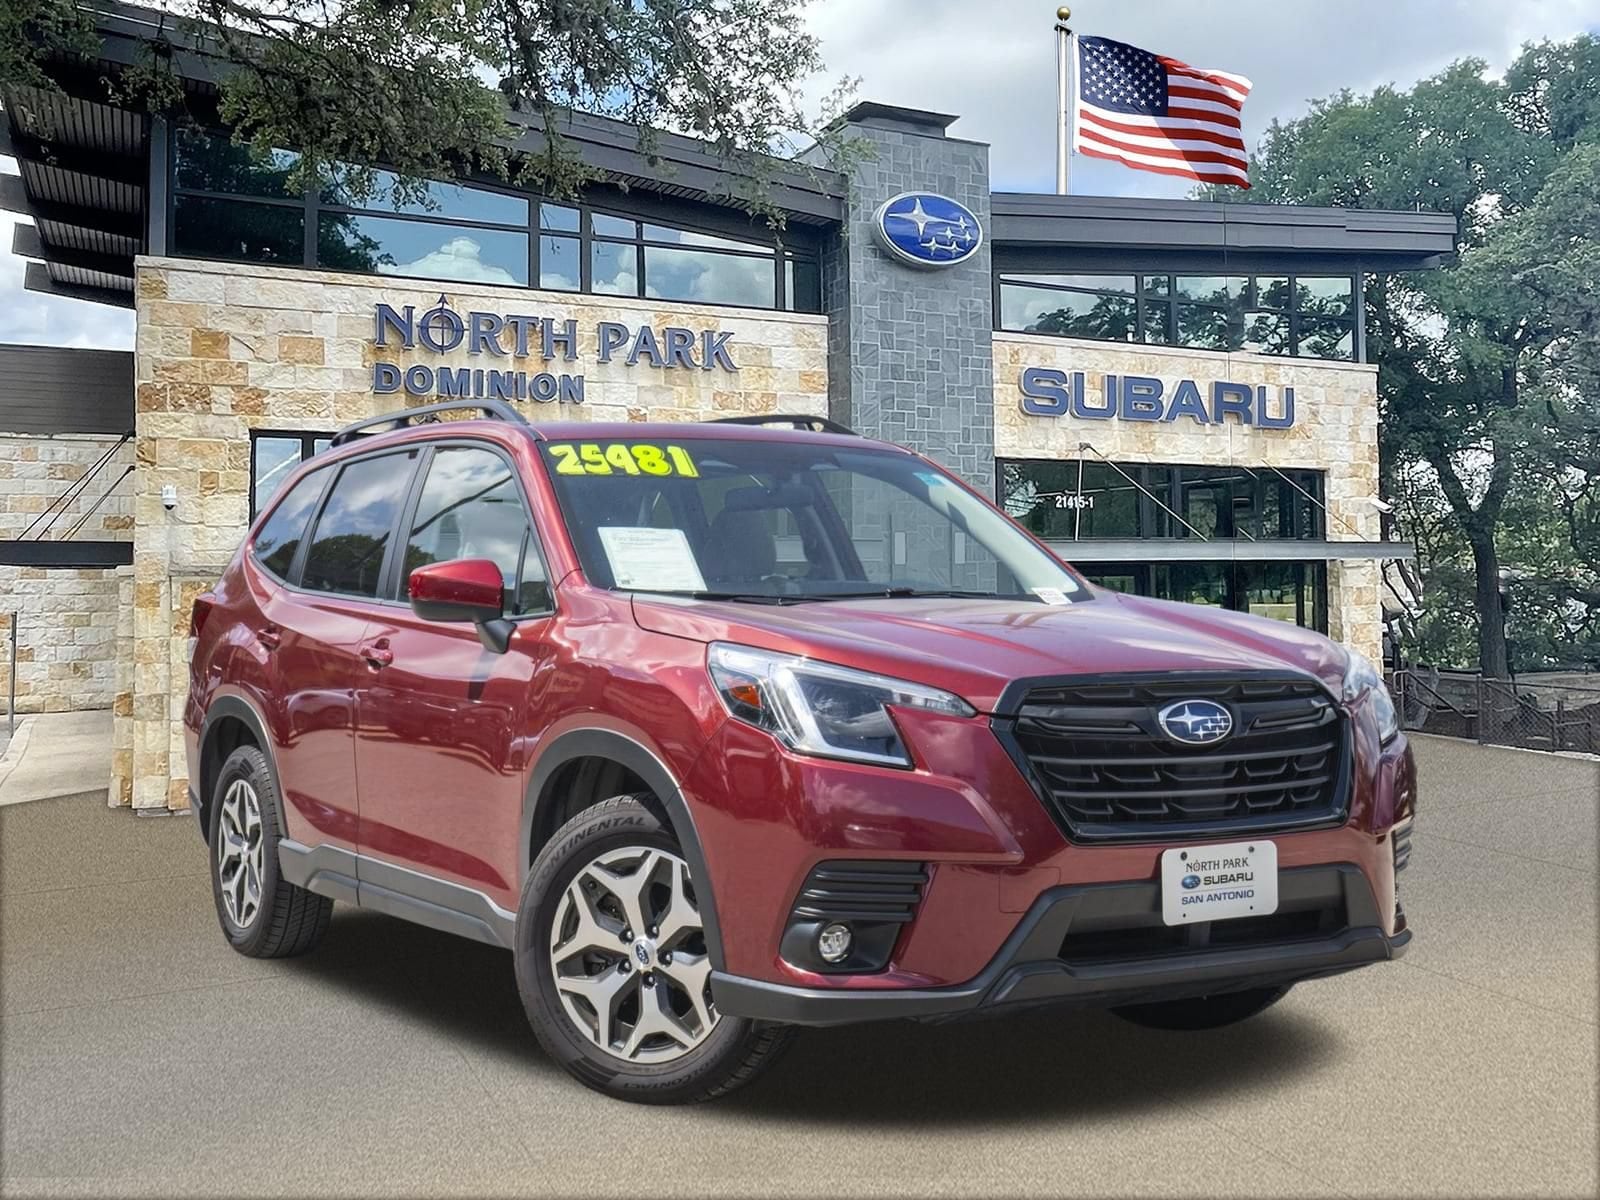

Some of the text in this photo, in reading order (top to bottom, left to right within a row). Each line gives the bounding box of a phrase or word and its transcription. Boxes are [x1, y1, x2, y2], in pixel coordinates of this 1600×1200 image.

[374, 294, 742, 373] NORTH PARK
[372, 362, 585, 404] DOMINION
[1019, 367, 1295, 430] SUBARU
[548, 443, 700, 478] 25481
[536, 816, 646, 892] CONTINENTAL
[1185, 857, 1249, 873] NORTH PARK
[1181, 889, 1255, 906] SAN ANTONIO
[1203, 872, 1254, 886] SUBARU
